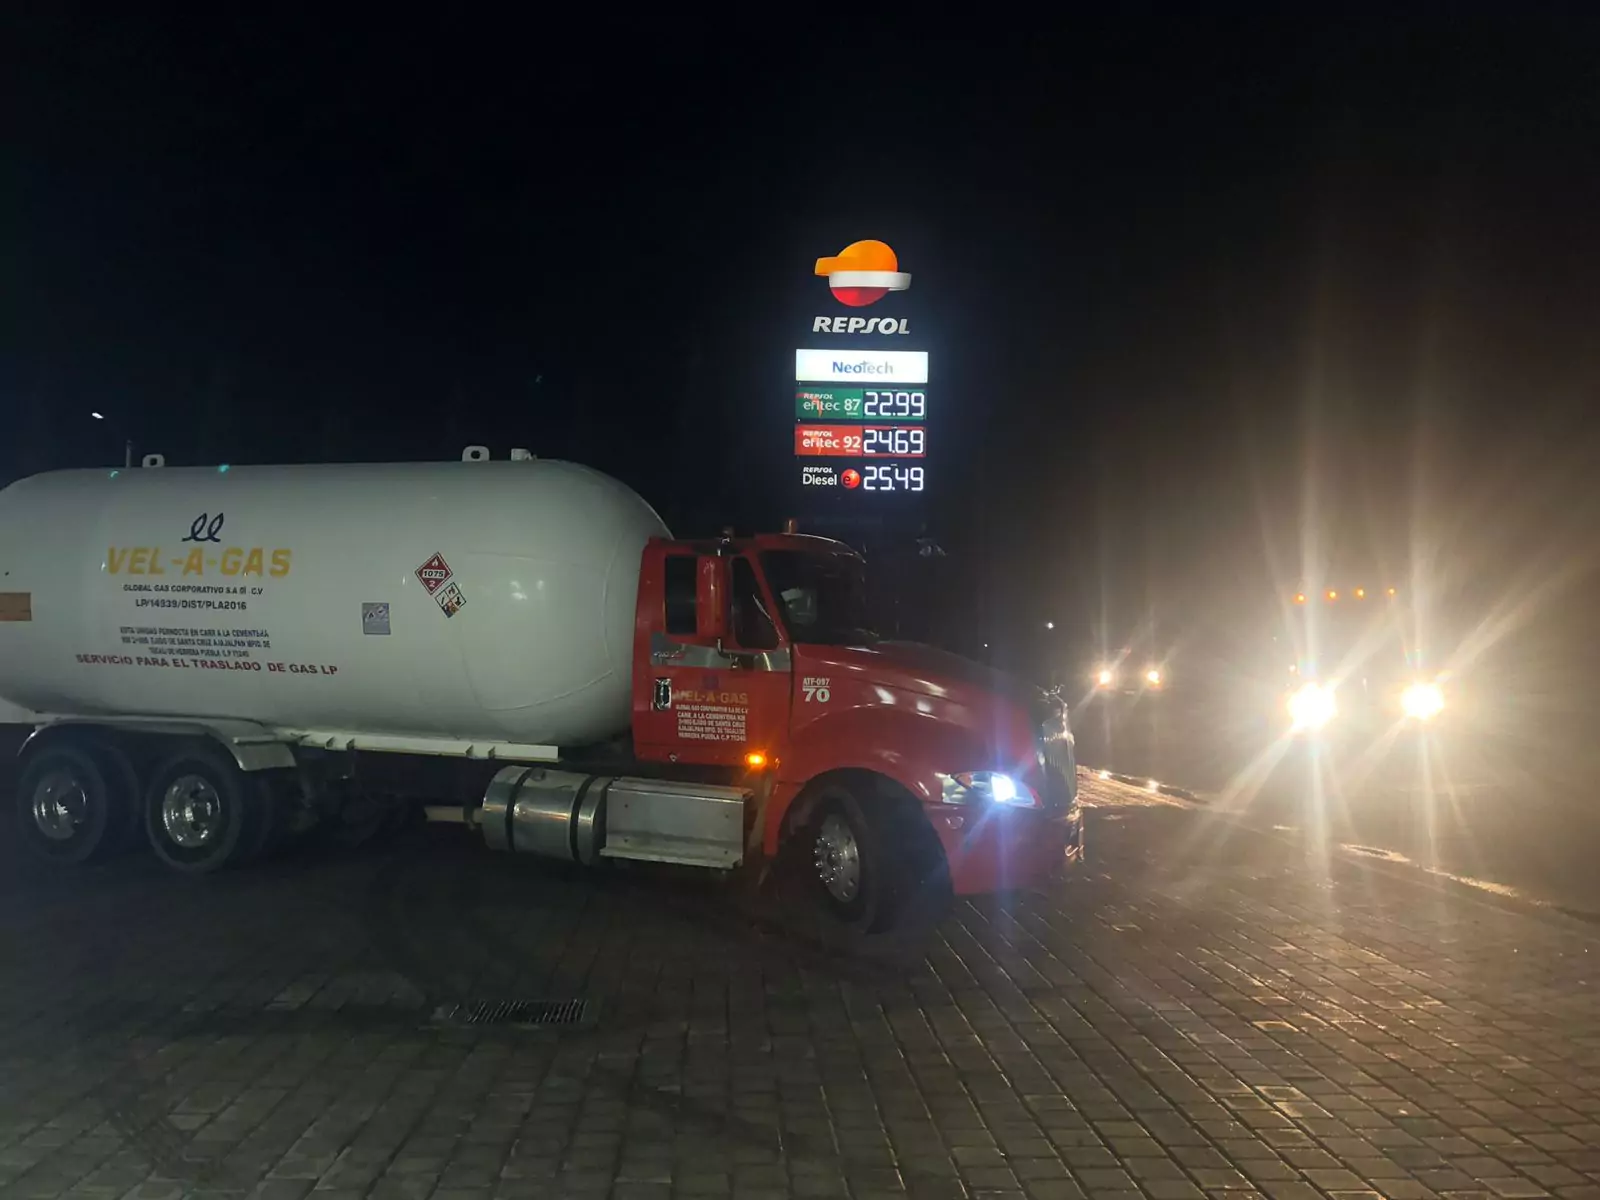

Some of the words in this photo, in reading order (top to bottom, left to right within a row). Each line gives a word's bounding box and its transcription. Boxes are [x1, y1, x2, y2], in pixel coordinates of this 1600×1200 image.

[812, 316, 910, 335] REPSOL
[832, 360, 894, 375] NeoTech
[844, 398, 861, 411] 87
[864, 391, 925, 416] 22.99
[843, 436, 861, 448] 92
[863, 429, 924, 453] 24.69
[802, 474, 837, 485] Diesel
[863, 466, 924, 491] 25.49
[123, 584, 152, 592] GLOBAL
[171, 585, 224, 594] CORPORATIVO
[222, 629, 231, 637] LA
[75, 654, 133, 666] SERVICIO
[136, 656, 170, 668] PARA
[173, 658, 189, 668] EL
[192, 658, 262, 671] TRASLADO
[267, 662, 286, 672] DE
[289, 663, 318, 674] GAS
[321, 665, 338, 675] LP
[802, 688, 830, 702] 70
